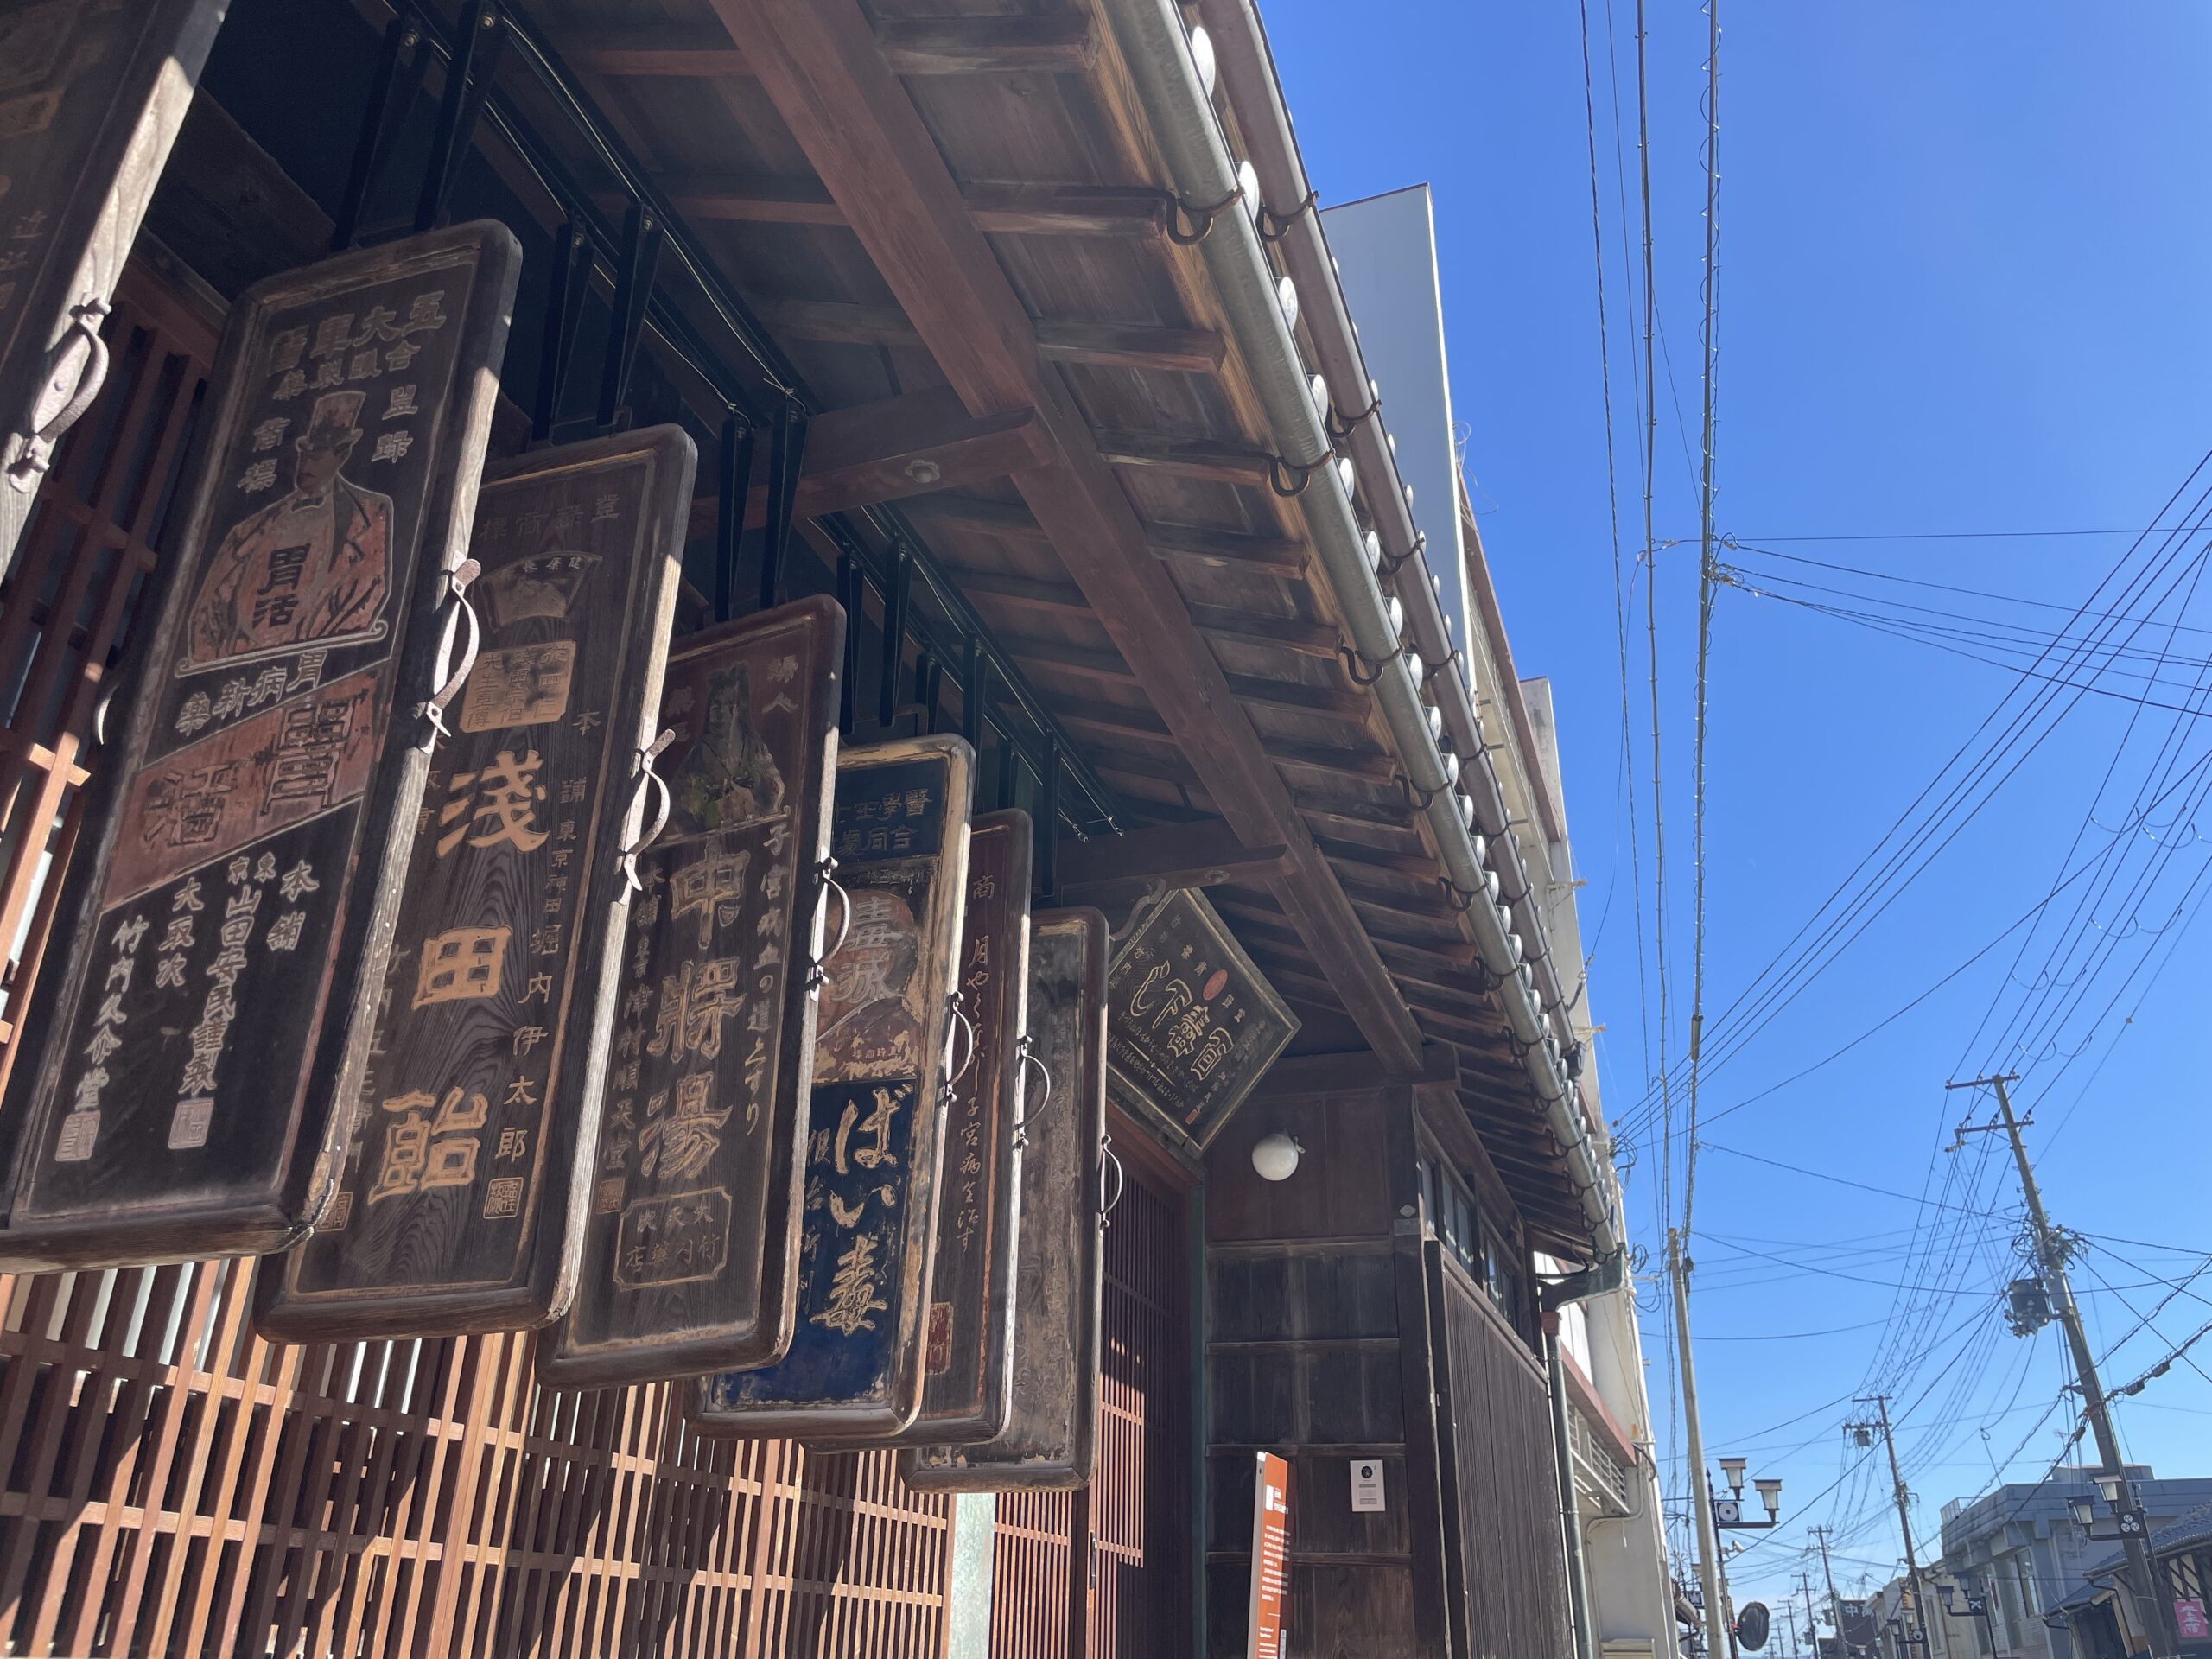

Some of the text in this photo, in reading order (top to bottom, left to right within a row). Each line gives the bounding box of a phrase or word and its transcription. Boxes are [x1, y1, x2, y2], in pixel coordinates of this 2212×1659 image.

[252, 543, 310, 627] 胃活
[156, 876, 205, 988] 大取次
